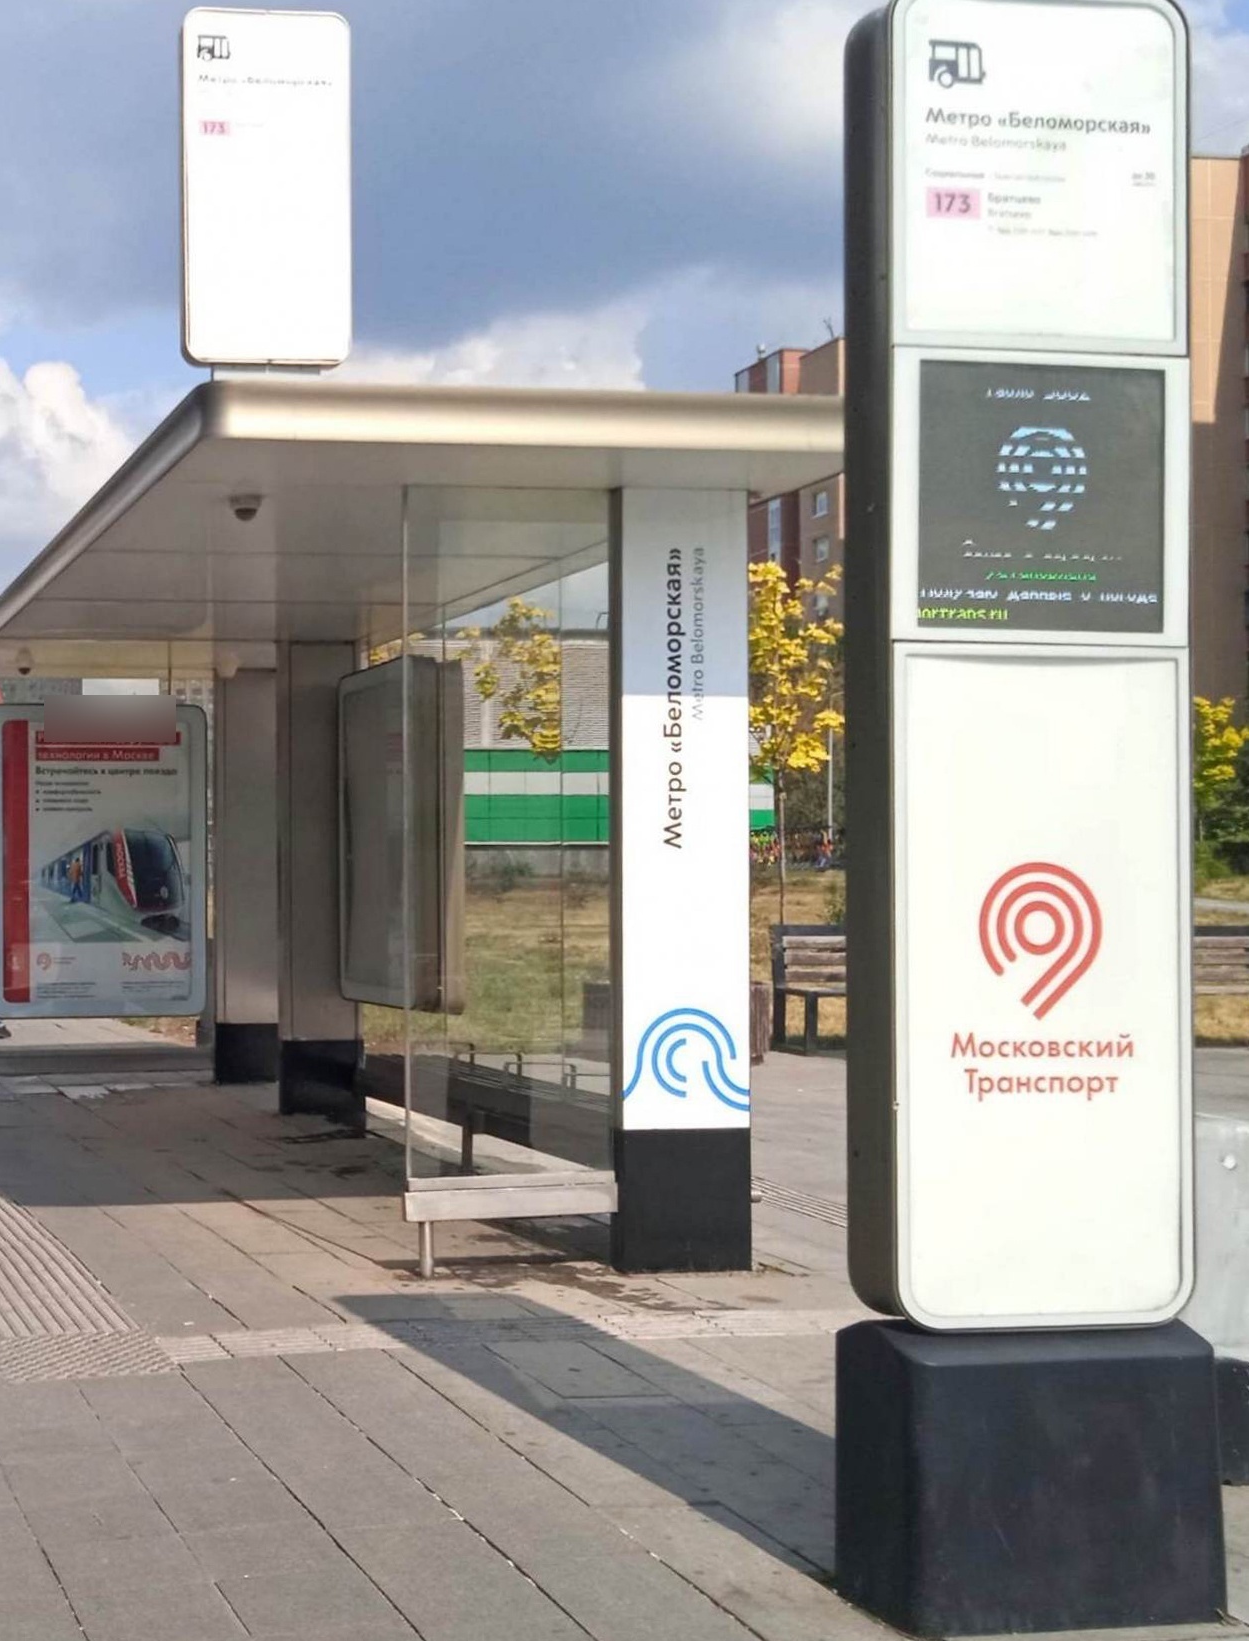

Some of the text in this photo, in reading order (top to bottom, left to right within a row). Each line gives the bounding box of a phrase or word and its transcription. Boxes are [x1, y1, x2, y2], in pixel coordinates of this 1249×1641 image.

[203, 121, 226, 135] 173
[925, 107, 1151, 134] Метро «Беломорская»
[925, 133, 968, 147] Metro
[935, 192, 971, 214] 173
[690, 547, 707, 721] Metro Belomorskaya
[663, 547, 687, 850] Метро «Беломорская»
[950, 1032, 1135, 1058] Московский
[964, 1068, 1119, 1102] Транспорт
